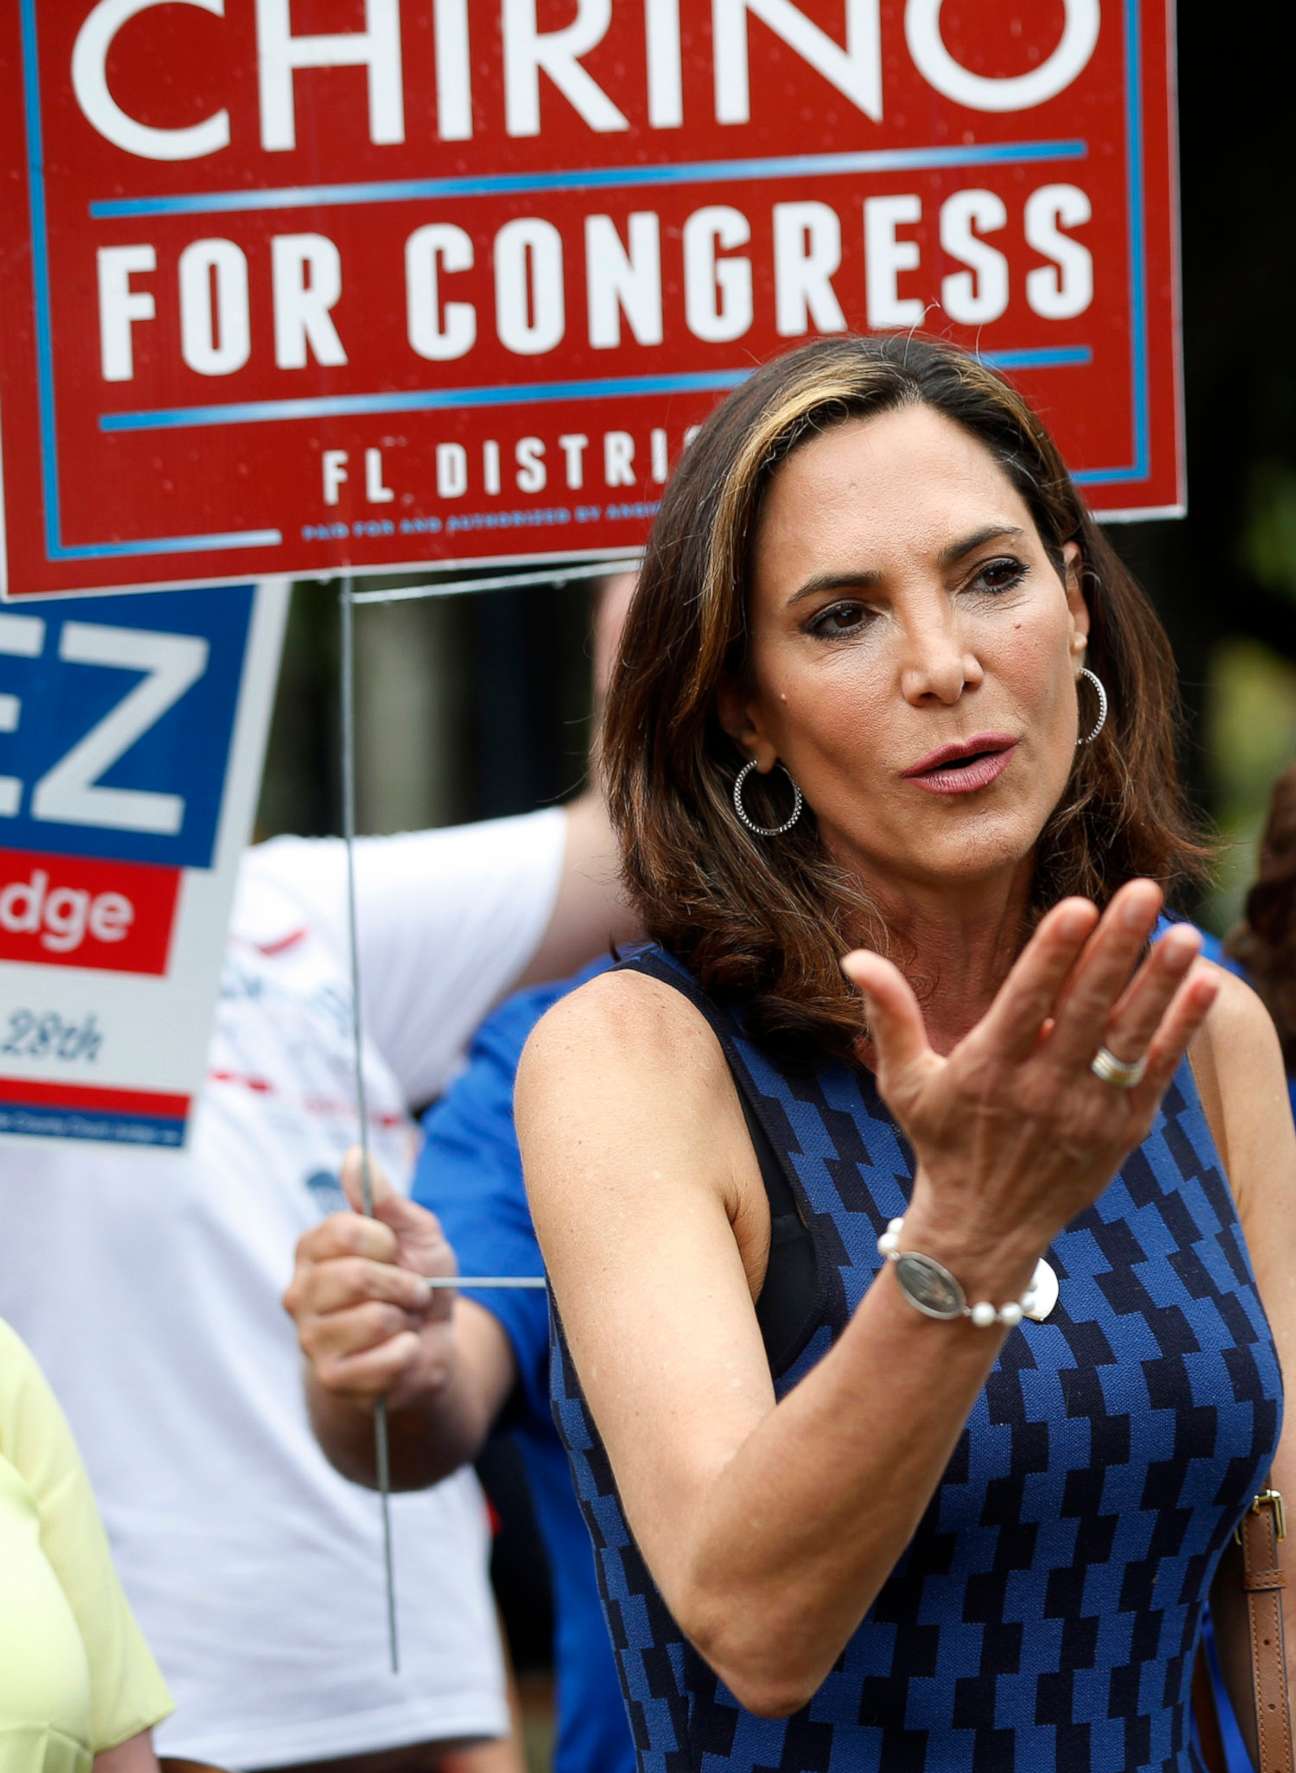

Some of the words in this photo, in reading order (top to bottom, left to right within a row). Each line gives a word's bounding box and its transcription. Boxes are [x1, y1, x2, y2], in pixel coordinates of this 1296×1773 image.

[70, 0, 1101, 162] CHIRINO
[97, 232, 349, 382] FOR
[404, 184, 1094, 361] CONGRESS
[322, 448, 395, 507] FL
[352, 519, 395, 538] FOR
[400, 516, 443, 535] AND
[2, 1006, 104, 1064] 28th
